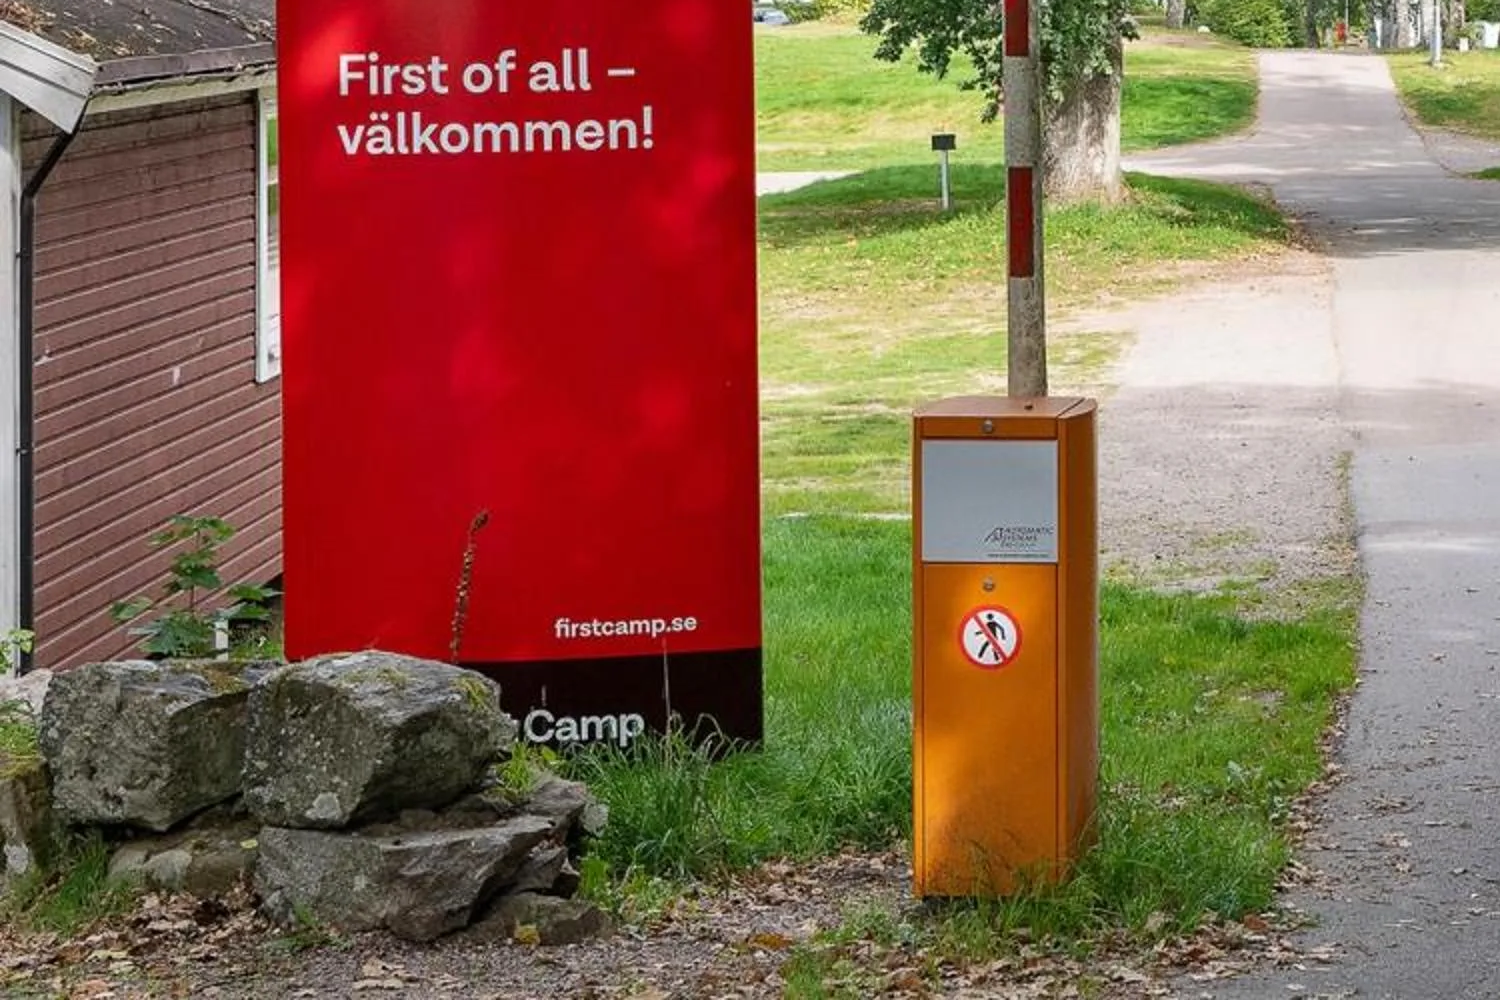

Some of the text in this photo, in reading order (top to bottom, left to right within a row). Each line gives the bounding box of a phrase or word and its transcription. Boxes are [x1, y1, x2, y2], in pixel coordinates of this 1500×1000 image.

[338, 51, 449, 96] First
[462, 49, 516, 93] of
[528, 47, 592, 91] all
[337, 105, 654, 155] välkommen!
[554, 615, 698, 638] firstcamp.se
[524, 709, 645, 747] Camp
